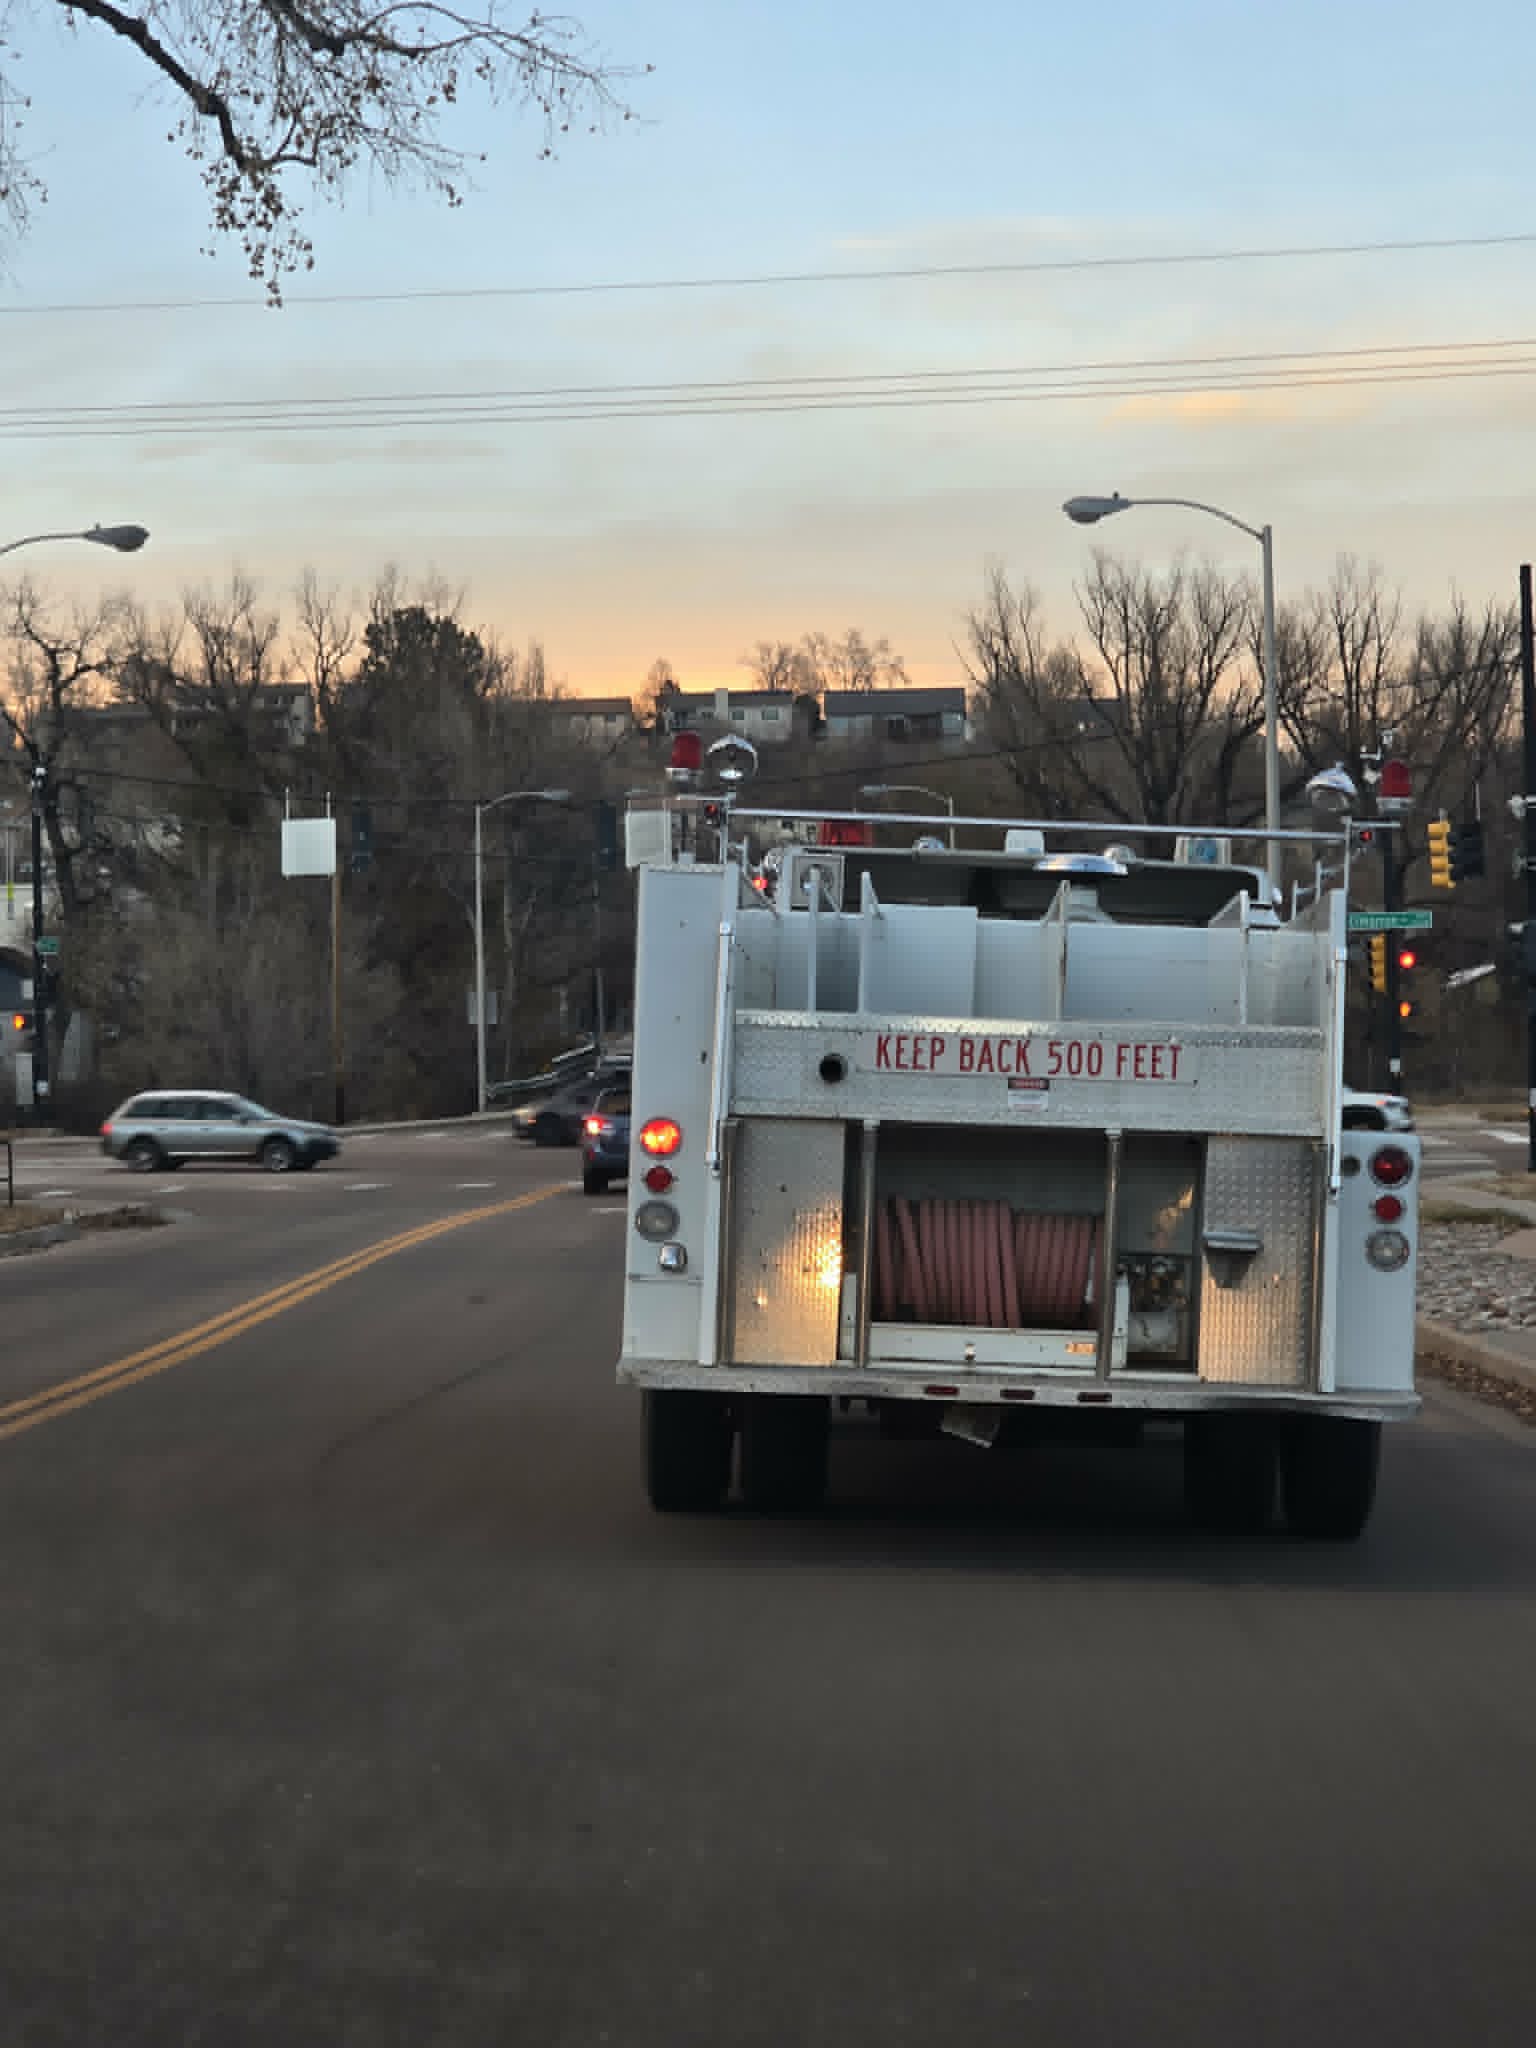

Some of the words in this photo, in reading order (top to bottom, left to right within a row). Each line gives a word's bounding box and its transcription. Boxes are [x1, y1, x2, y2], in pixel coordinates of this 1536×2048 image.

[875, 1034, 945, 1070] KEEP
[958, 1037, 1032, 1076] BACK
[1047, 1041, 1103, 1077] 500
[1115, 1043, 1183, 1079] FEET
